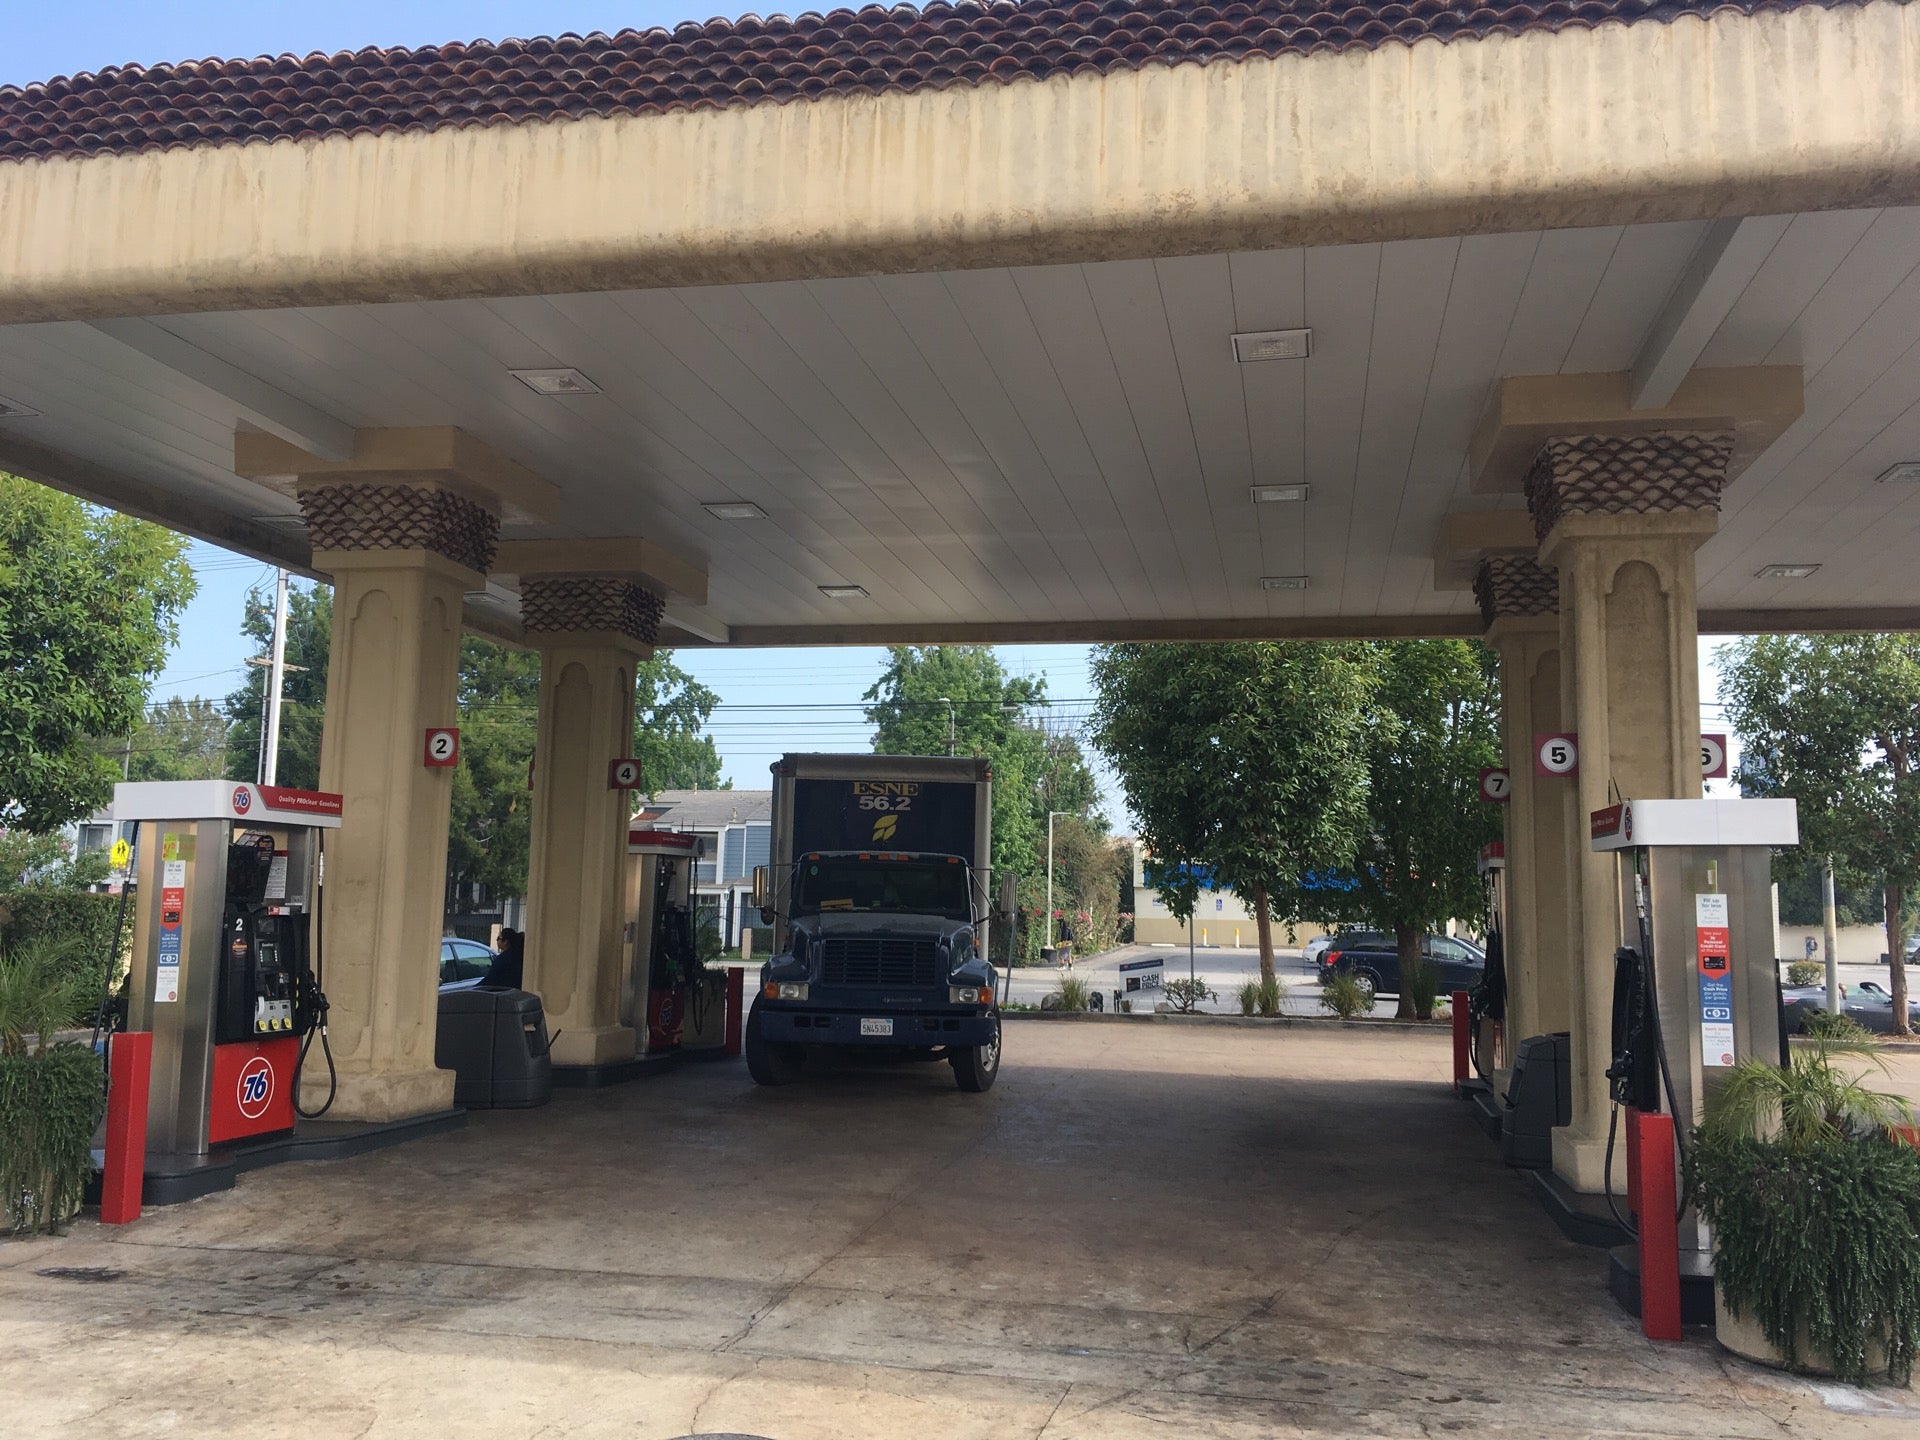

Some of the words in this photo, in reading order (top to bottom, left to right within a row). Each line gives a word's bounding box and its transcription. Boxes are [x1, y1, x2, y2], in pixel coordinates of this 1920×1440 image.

[436, 739, 447, 754] 2
[1551, 747, 1567, 764] 5
[621, 768, 631, 779] 4
[852, 782, 918, 796] ESNE
[1492, 779, 1504, 792] 7
[234, 791, 249, 807] 76
[279, 795, 296, 805] Quality
[319, 800, 340, 809] Gasolines
[859, 796, 911, 811] 56.2
[235, 918, 243, 931] 2
[1141, 973, 1160, 983] CASH
[1141, 980, 1160, 990] PRICE
[862, 1024, 891, 1033] 5N45383
[242, 1069, 269, 1104] 76
